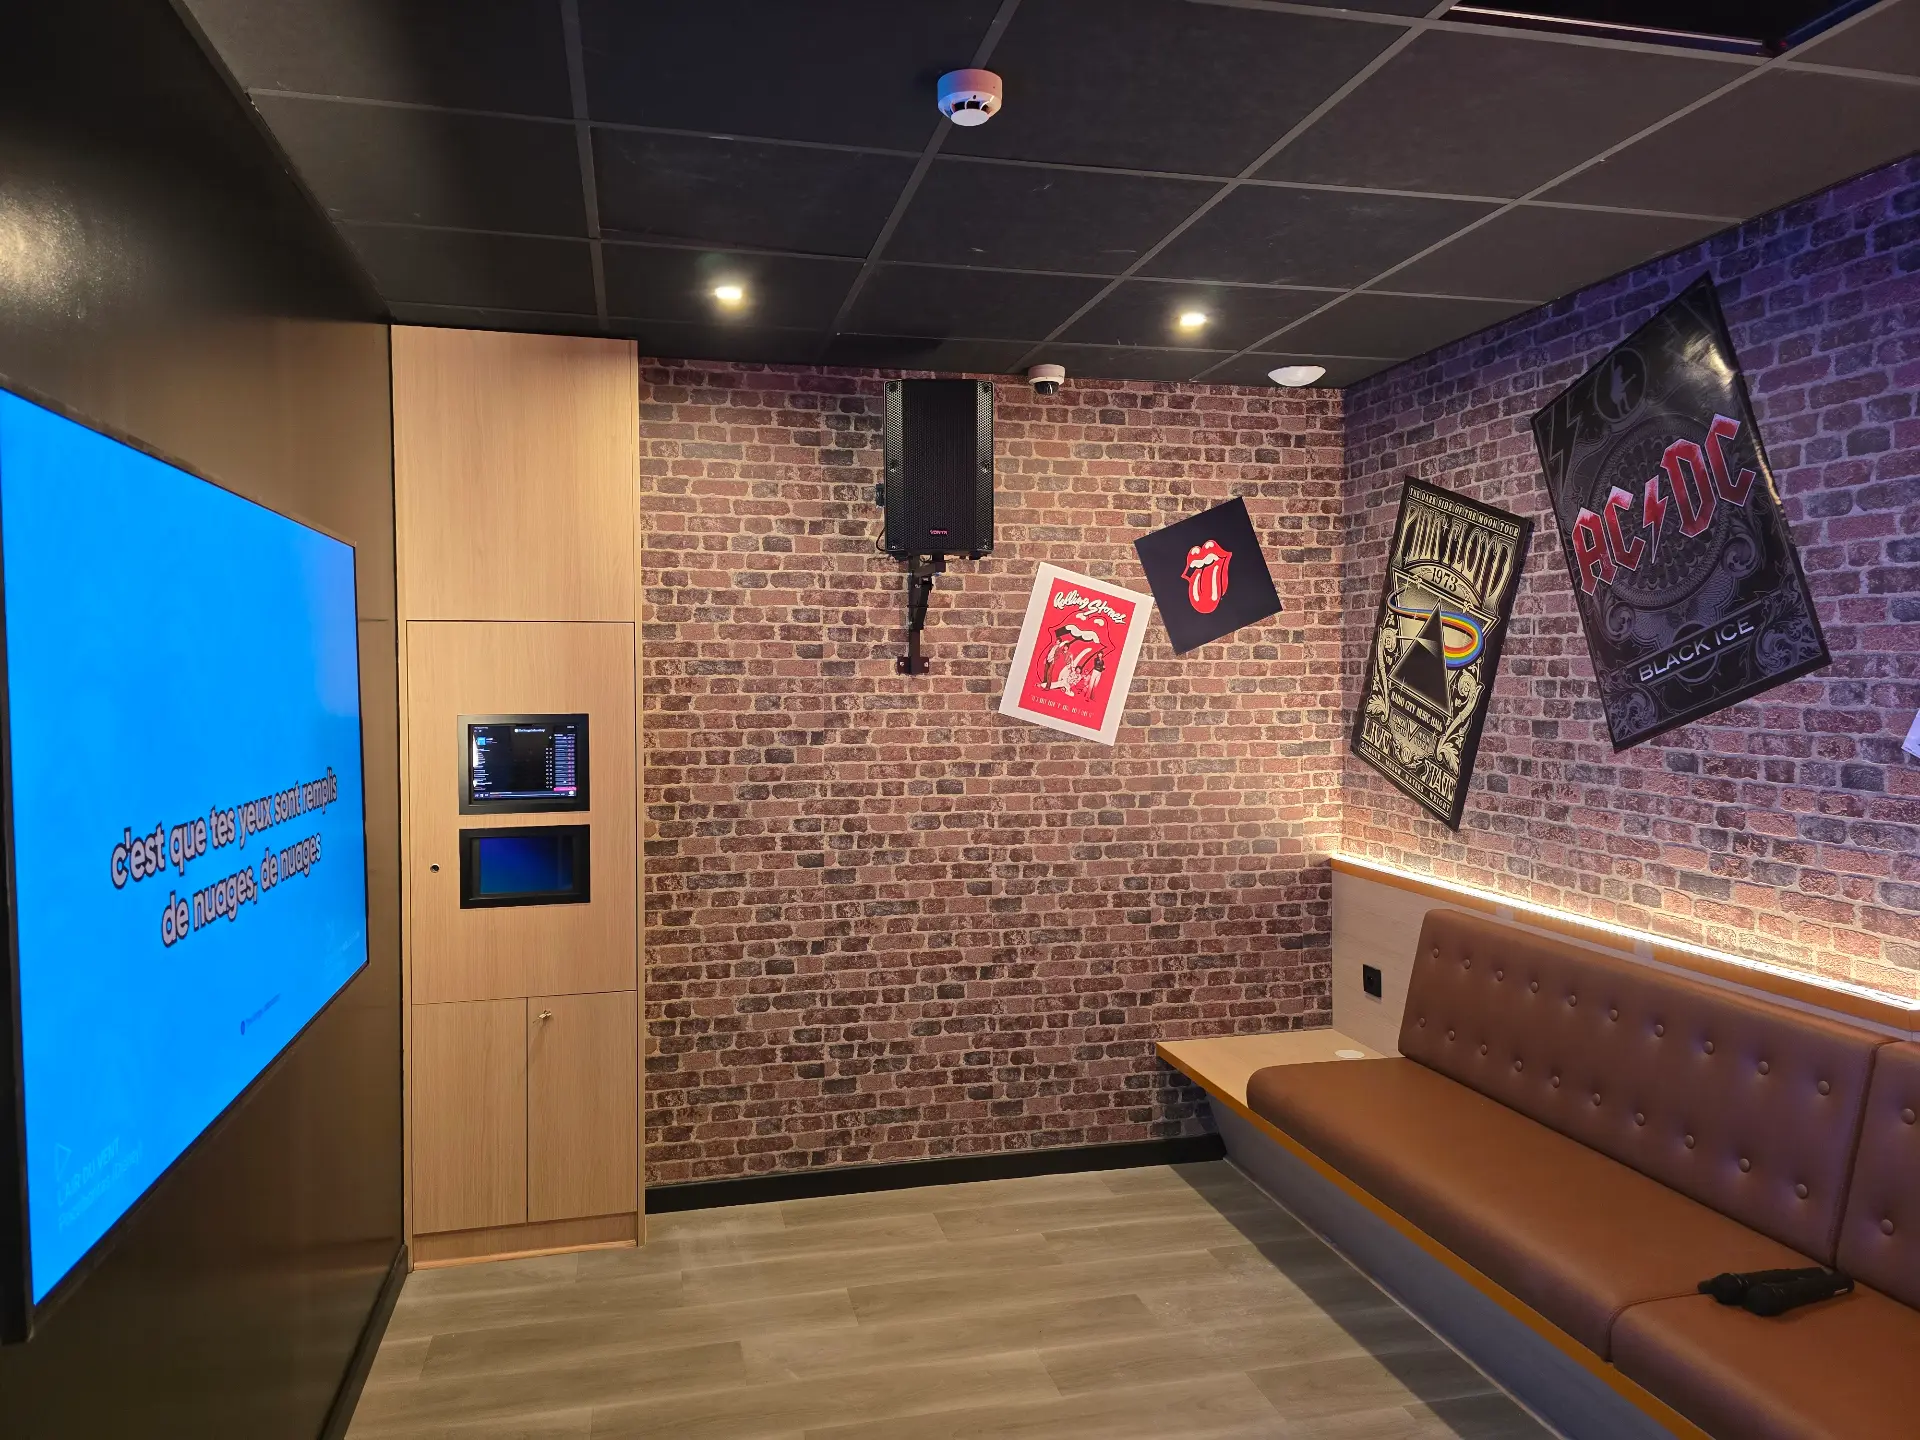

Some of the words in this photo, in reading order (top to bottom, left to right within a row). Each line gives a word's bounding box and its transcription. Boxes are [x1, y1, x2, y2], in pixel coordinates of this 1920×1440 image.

[1421, 493, 1437, 506] DARK
[1438, 499, 1452, 512] SIDE
[1454, 505, 1462, 515] OF
[1464, 509, 1477, 519] THE
[1479, 513, 1498, 529] MOON
[1499, 521, 1519, 537] TOUR
[1432, 567, 1458, 592] 1973
[1053, 590, 1090, 610] Rolling
[1083, 599, 1127, 625] Stones
[1639, 636, 1711, 682] BLACK
[1714, 615, 1755, 646] ICE
[111, 821, 165, 889] c'est
[169, 816, 207, 876] que
[210, 805, 235, 849] tes
[238, 794, 273, 849] yeux
[274, 780, 301, 825] sont
[302, 766, 337, 814] remplis
[161, 891, 189, 948] de
[193, 866, 259, 932] nuages,
[260, 848, 278, 891] de
[279, 833, 321, 881] nuages
